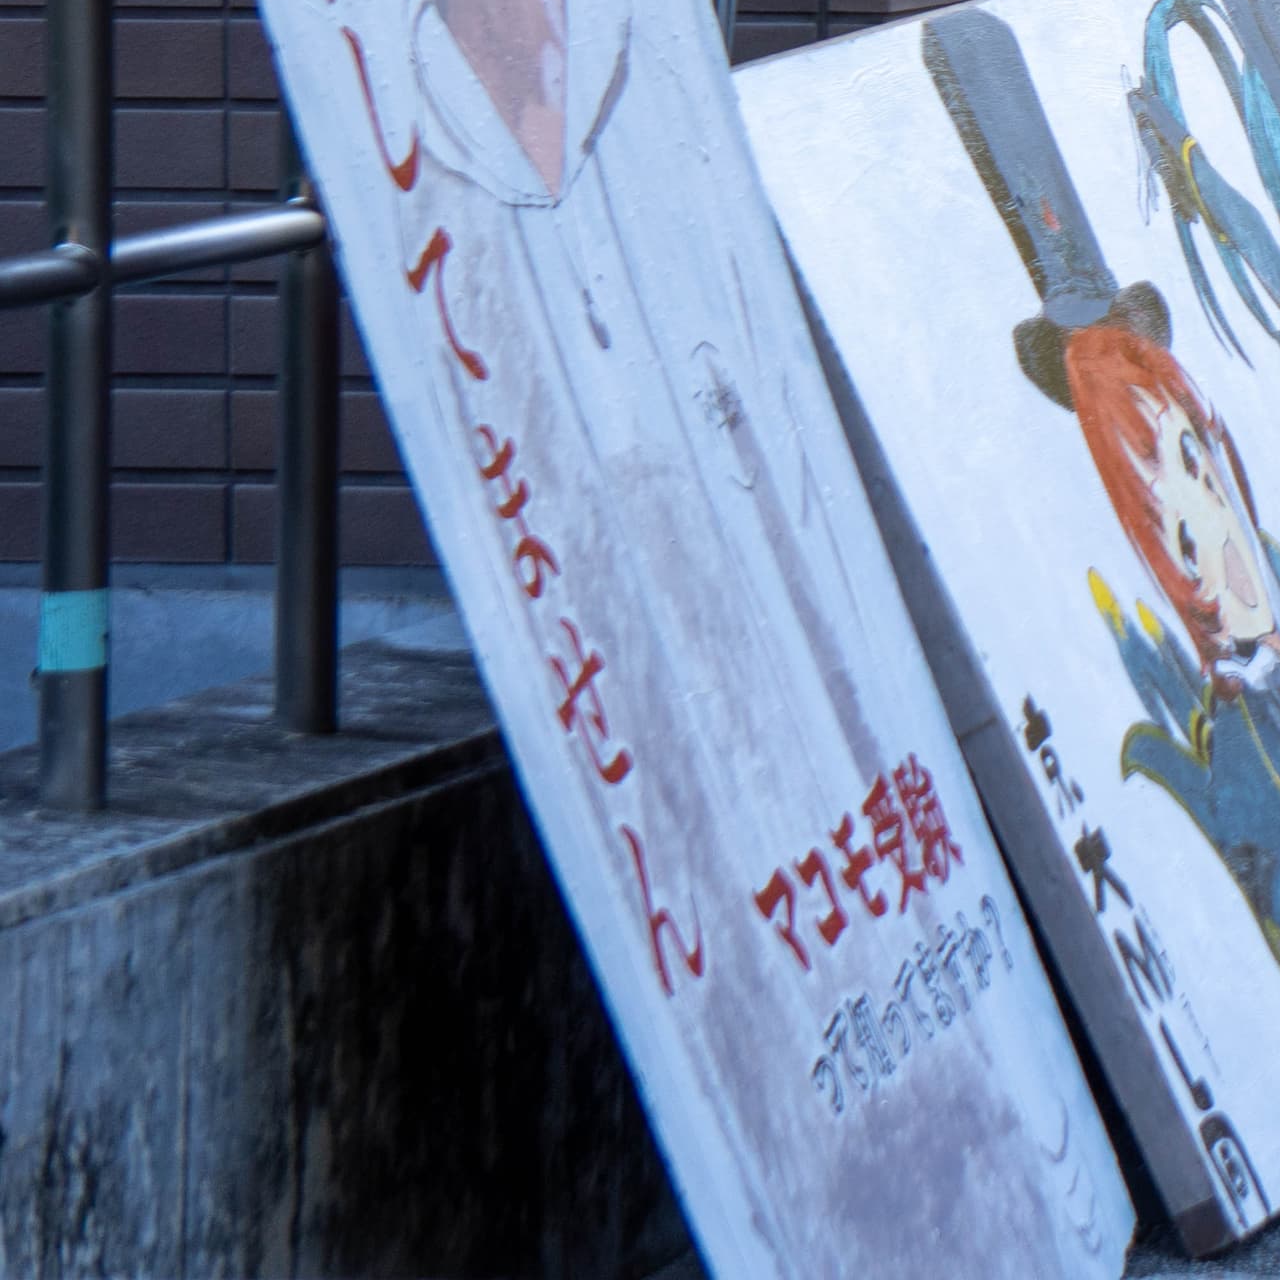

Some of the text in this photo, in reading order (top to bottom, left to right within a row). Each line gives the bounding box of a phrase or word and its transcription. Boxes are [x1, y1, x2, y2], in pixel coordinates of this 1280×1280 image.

[754, 752, 965, 973] マコモ受験
